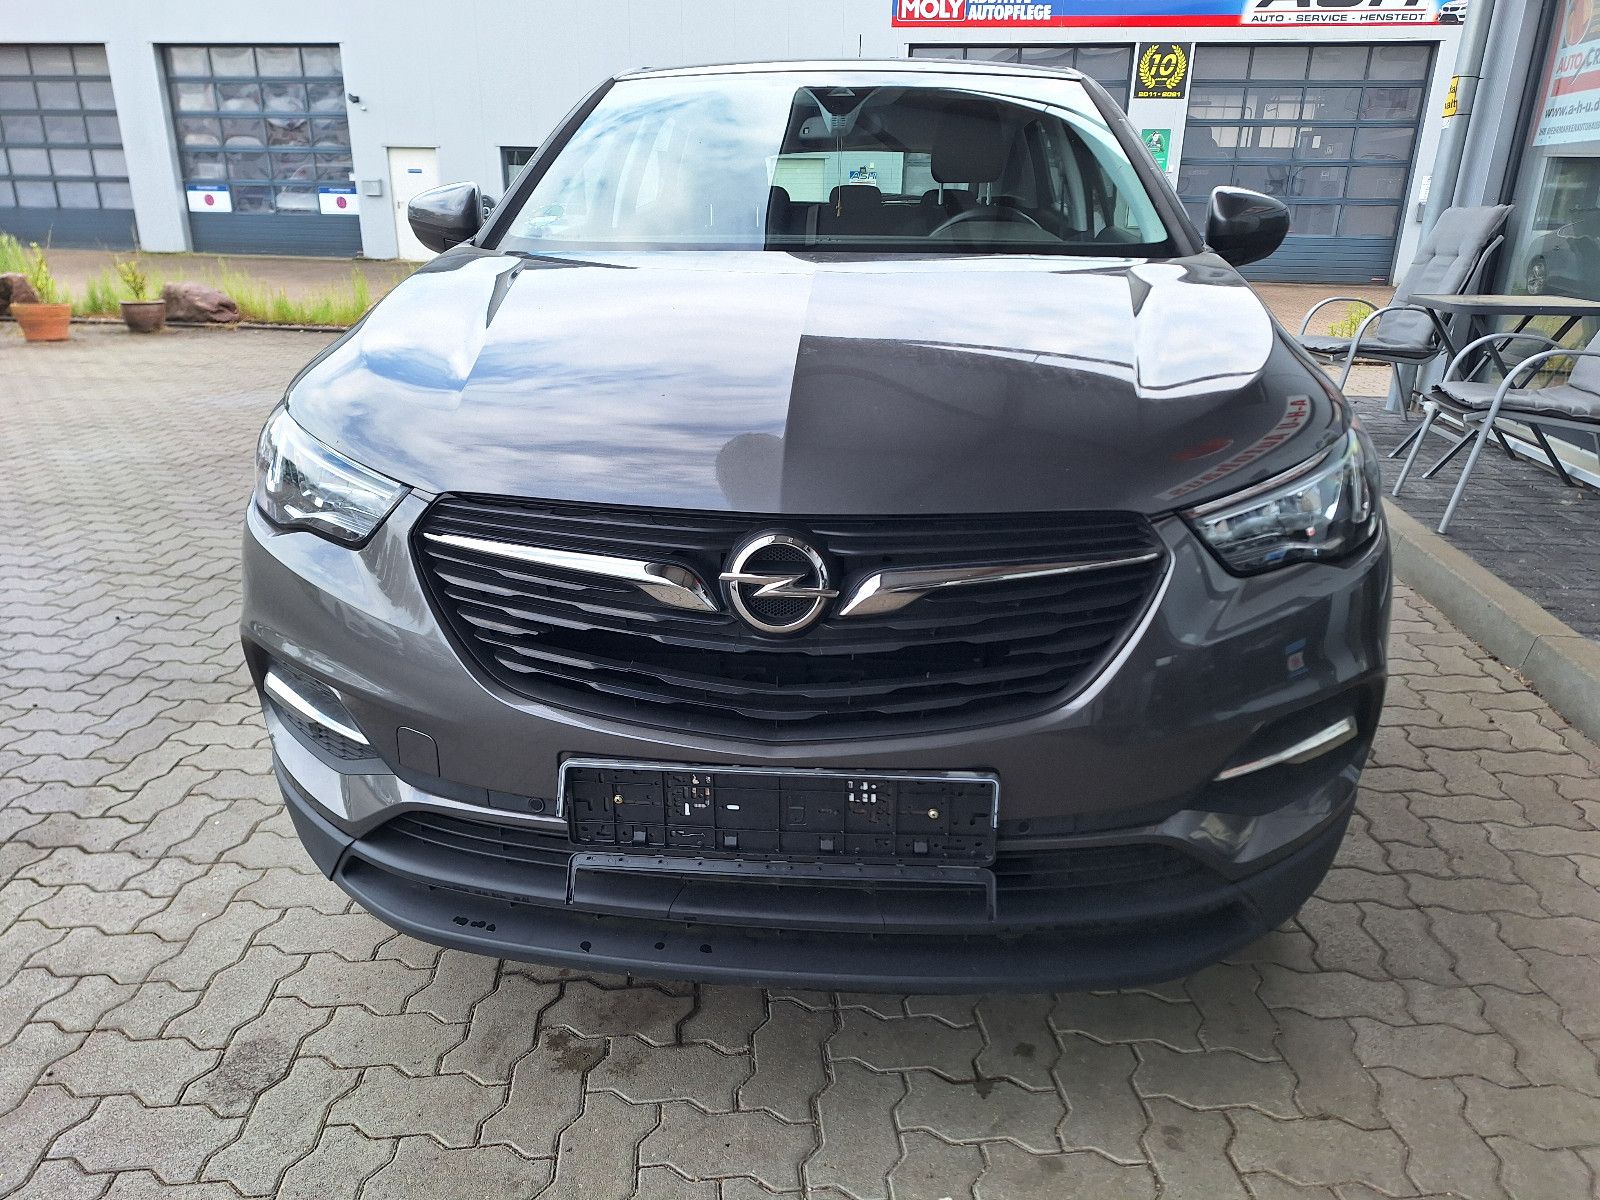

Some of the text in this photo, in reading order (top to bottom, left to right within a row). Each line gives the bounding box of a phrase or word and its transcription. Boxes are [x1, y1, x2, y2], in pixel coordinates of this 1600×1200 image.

[901, 0, 965, 19] MOLY
[967, 4, 1052, 20] AUTOPFLEGE
[1295, 14, 1347, 22] SERVICE
[1359, 13, 1426, 21] HENSTEDT
[1150, 54, 1178, 76] 10
